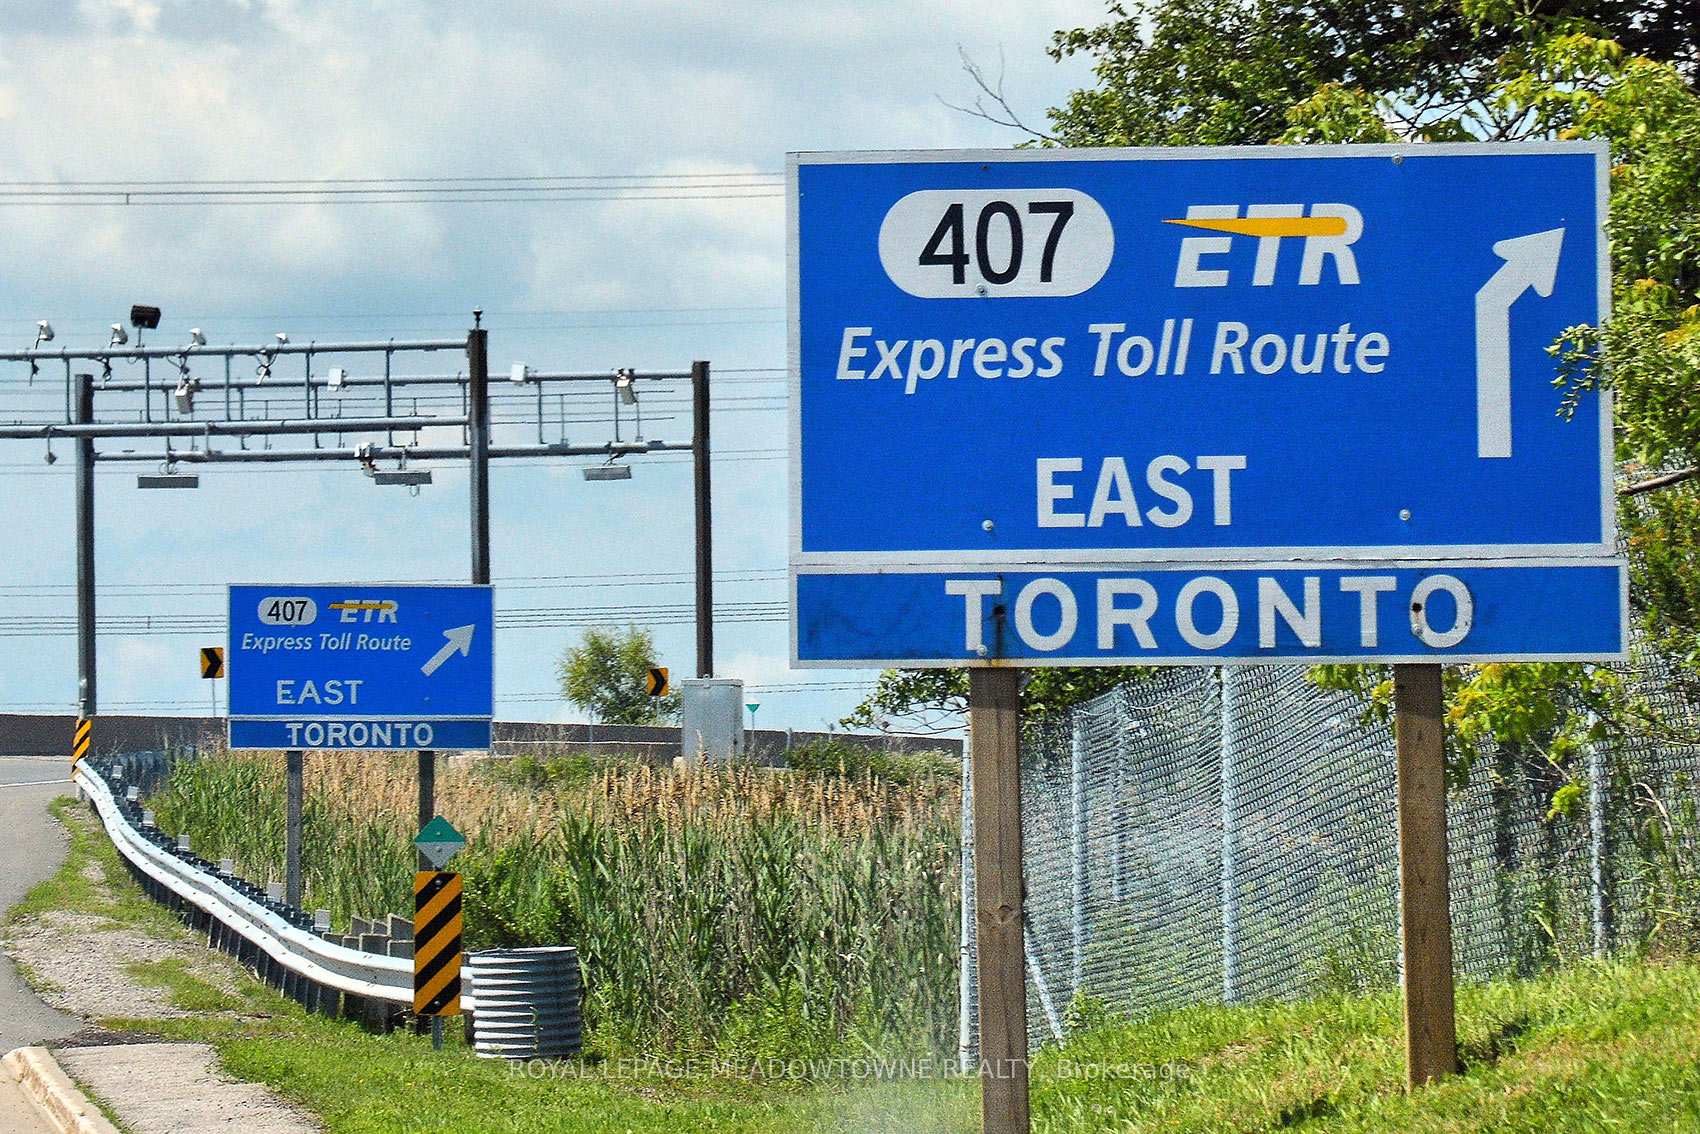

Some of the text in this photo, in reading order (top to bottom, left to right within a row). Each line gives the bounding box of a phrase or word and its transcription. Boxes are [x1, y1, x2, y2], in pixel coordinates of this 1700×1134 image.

[917, 201, 1365, 289] 407 ETR
[835, 317, 1391, 395] Express Toll Route
[1036, 453, 1248, 529] EAST
[267, 599, 400, 625] 407 ETR
[944, 573, 1475, 653] TORONTO
[240, 632, 412, 655] Express Toll Route
[275, 679, 365, 706] EAST
[285, 722, 434, 748] TORONTO
